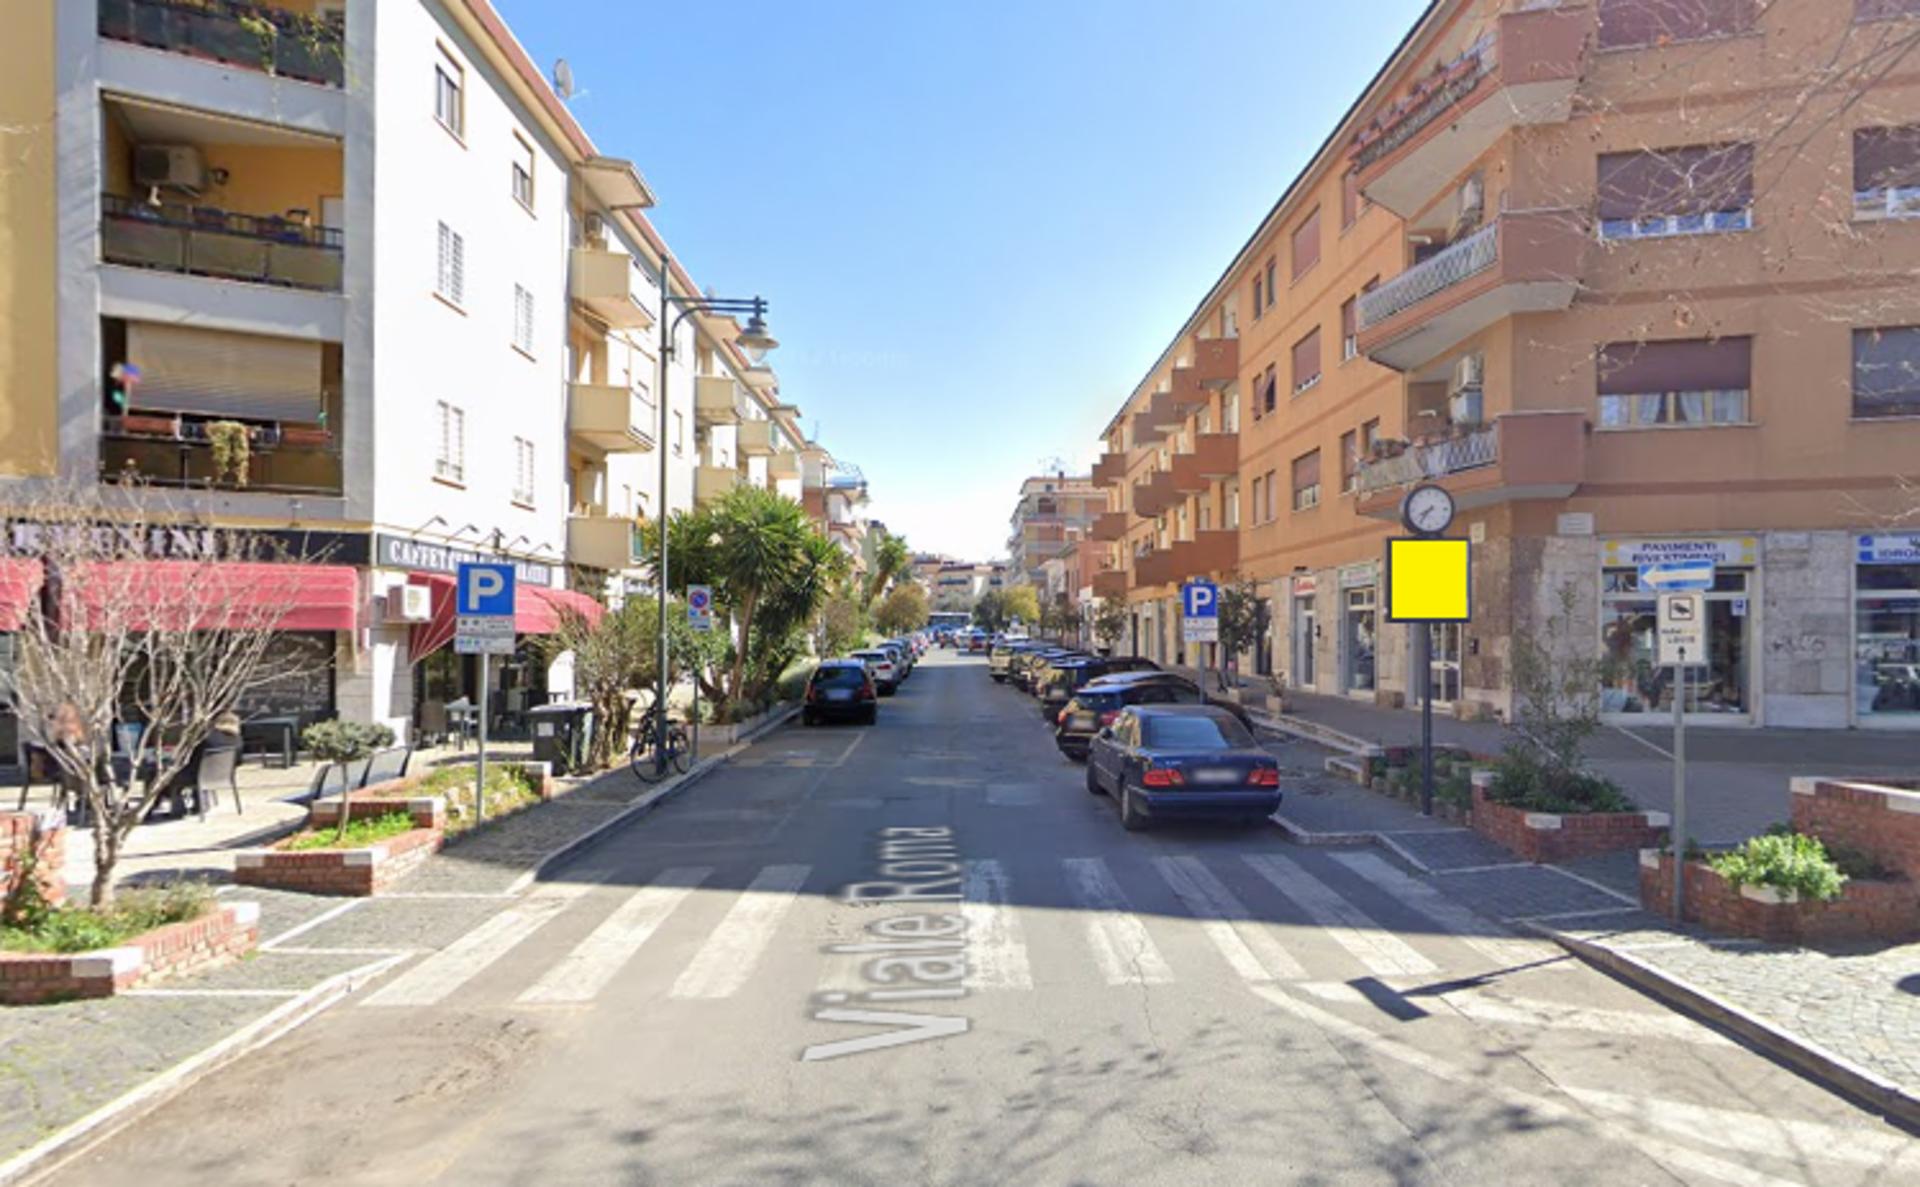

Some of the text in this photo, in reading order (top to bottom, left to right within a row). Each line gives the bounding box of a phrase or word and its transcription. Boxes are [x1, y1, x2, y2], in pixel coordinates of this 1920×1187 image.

[1641, 542, 1718, 552] PAVIMENTI
[468, 568, 504, 610] P
[1191, 586, 1212, 615] P
